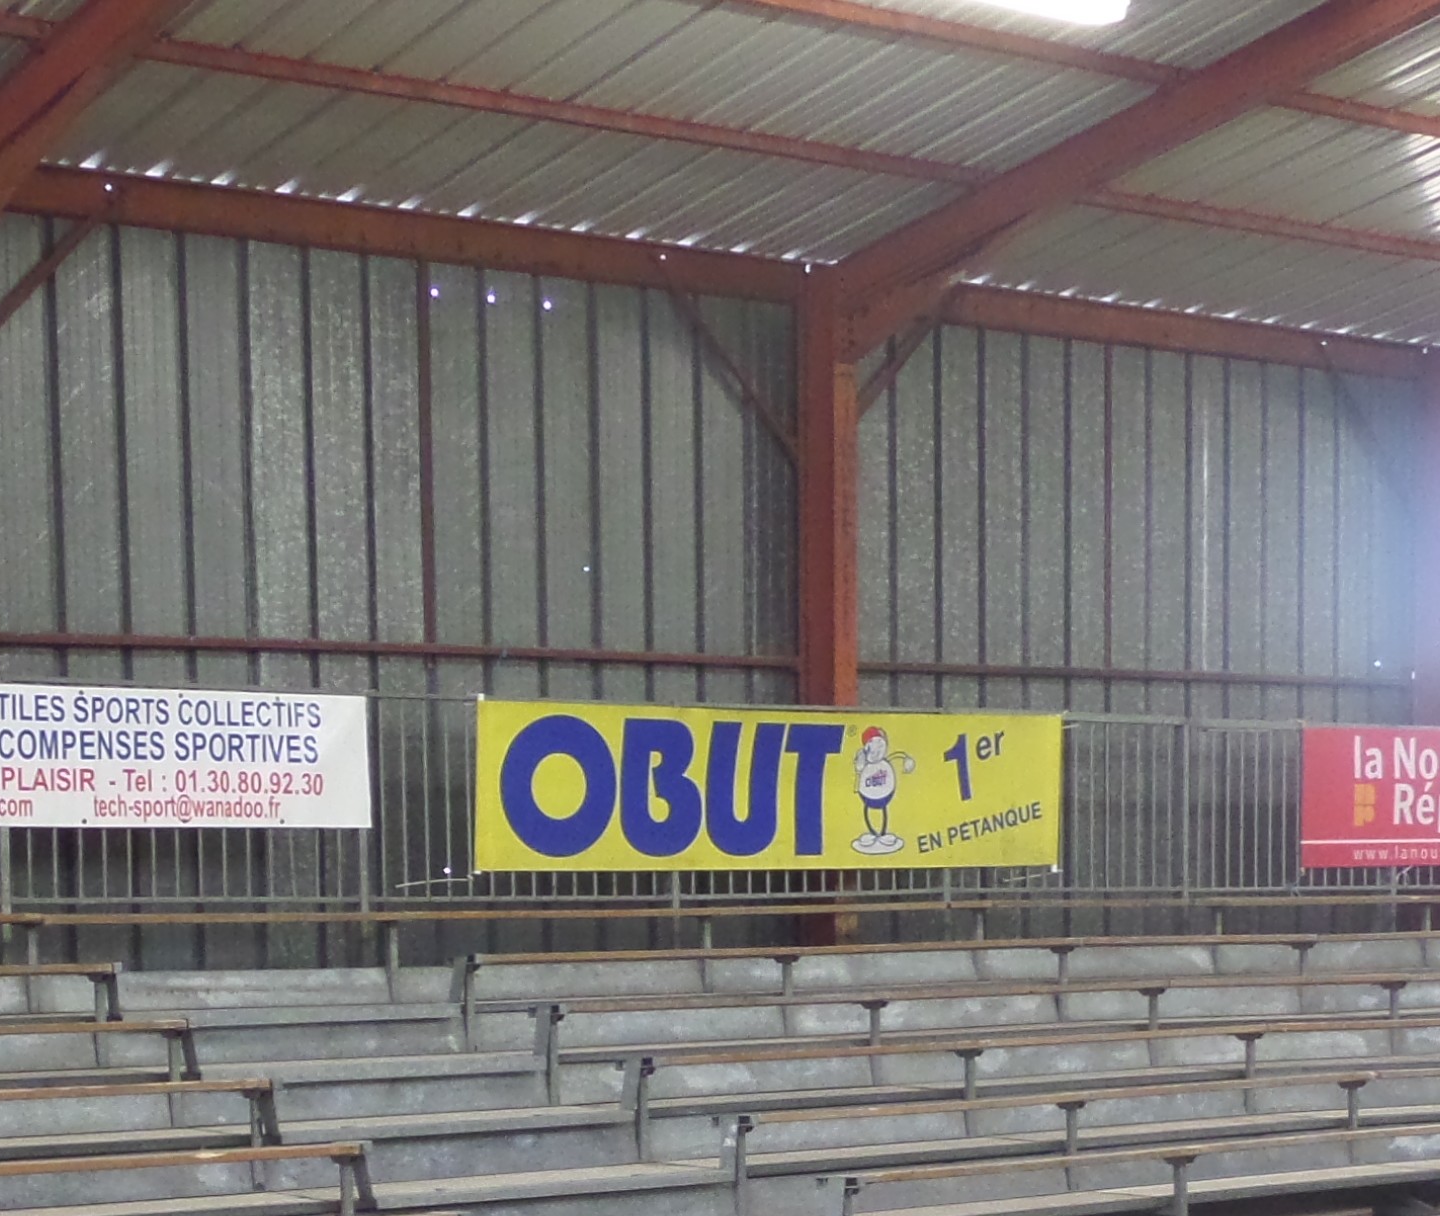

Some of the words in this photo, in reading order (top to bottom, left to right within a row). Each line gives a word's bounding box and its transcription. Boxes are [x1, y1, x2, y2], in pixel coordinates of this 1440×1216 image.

[74, 696, 170, 725] SPORTS
[178, 699, 322, 728] COLLECTIFS
[174, 732, 319, 764] SPORTIVES
[1354, 736, 1383, 779] la
[1, 767, 96, 792] PLAISIR
[123, 769, 152, 792] Tel
[175, 770, 323, 795] 01.30.80.92.30
[944, 731, 1005, 801] 1er
[500, 714, 845, 857] OBUT
[94, 794, 281, 823] tech-sport@wanadoo.fr
[918, 832, 942, 854] EN
